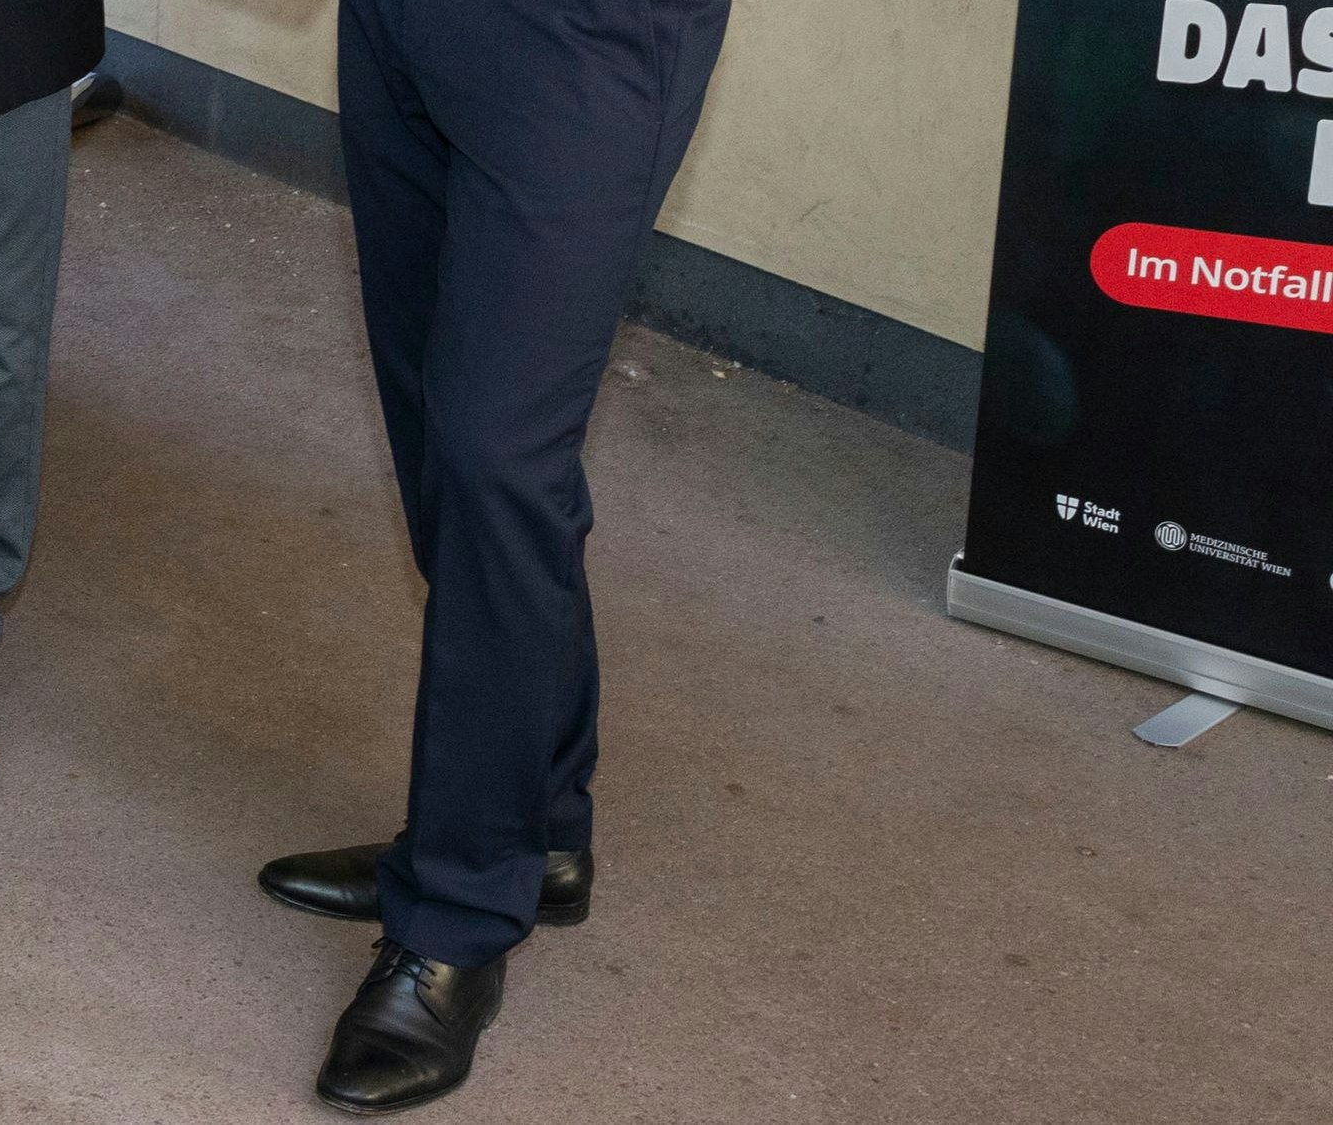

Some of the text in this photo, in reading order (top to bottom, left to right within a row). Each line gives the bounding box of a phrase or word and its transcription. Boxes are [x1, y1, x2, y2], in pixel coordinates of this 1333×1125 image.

[1127, 248, 1333, 304] Im Notfall
[1083, 501, 1121, 522] Stadt
[1083, 513, 1119, 535] Wien
[1189, 532, 1269, 561] MEDIZINISCHE
[1189, 542, 1293, 577] UNIVERSITÄT WIEN
